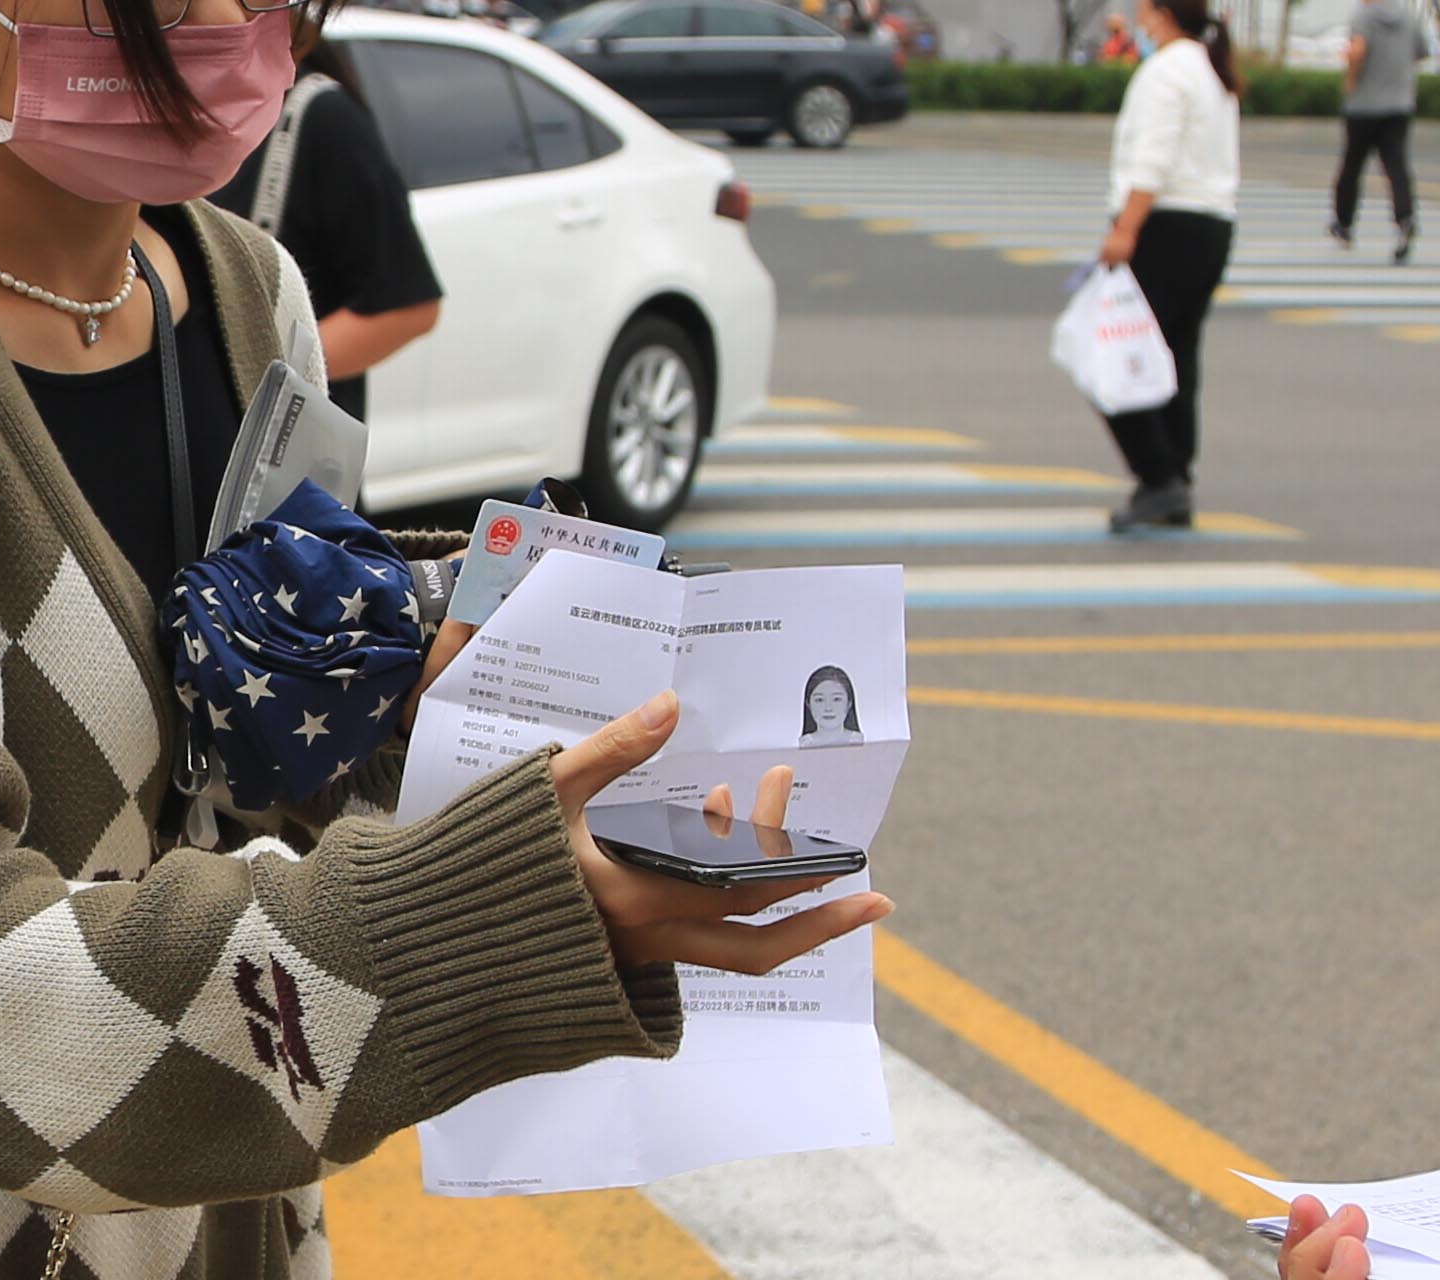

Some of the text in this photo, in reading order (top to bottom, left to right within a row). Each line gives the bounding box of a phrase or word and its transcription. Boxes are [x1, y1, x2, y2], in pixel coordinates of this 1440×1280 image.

[541, 526, 639, 558] 中华人民共和国
[503, 728, 519, 738] A01
